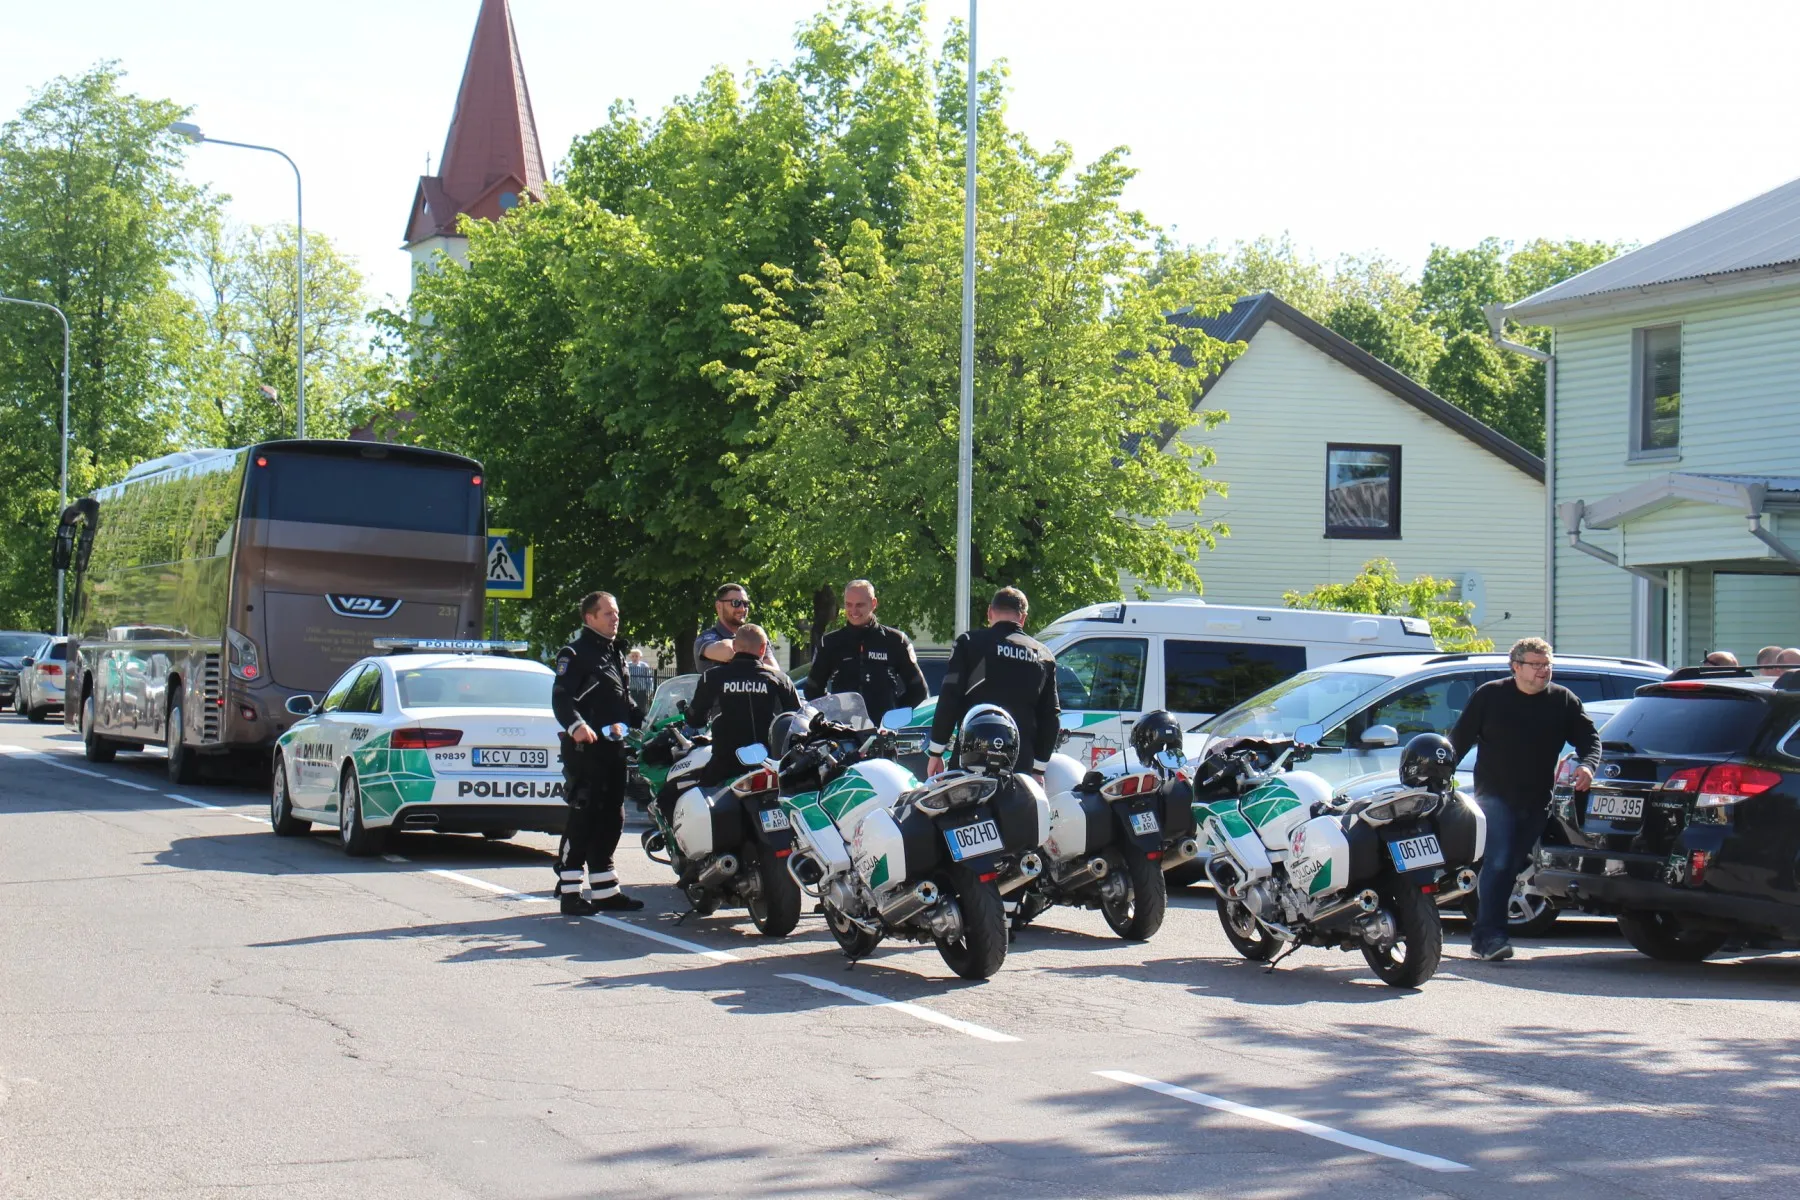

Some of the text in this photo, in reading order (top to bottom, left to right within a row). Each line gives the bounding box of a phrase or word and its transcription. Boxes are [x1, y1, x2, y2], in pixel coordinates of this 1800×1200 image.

[338, 596, 387, 612] VDL
[426, 641, 484, 649] POLICIJA
[868, 651, 888, 661] POLICIJA
[997, 645, 1038, 663] POLICIJA
[723, 681, 768, 694] POLICIJA
[435, 752, 467, 761] R9839
[481, 750, 511, 763] KCV
[520, 751, 545, 764] 039
[458, 781, 565, 798] POLICIJA
[1593, 797, 1615, 814] JPO
[1620, 799, 1642, 816] 395
[1652, 801, 1684, 809] OUTBACK
[772, 810, 783, 819] 56
[1141, 813, 1152, 822] 55
[773, 818, 788, 828] ARU
[1142, 821, 1157, 831] ARU
[956, 823, 997, 848] 062HD
[1399, 836, 1439, 860] 061HD
